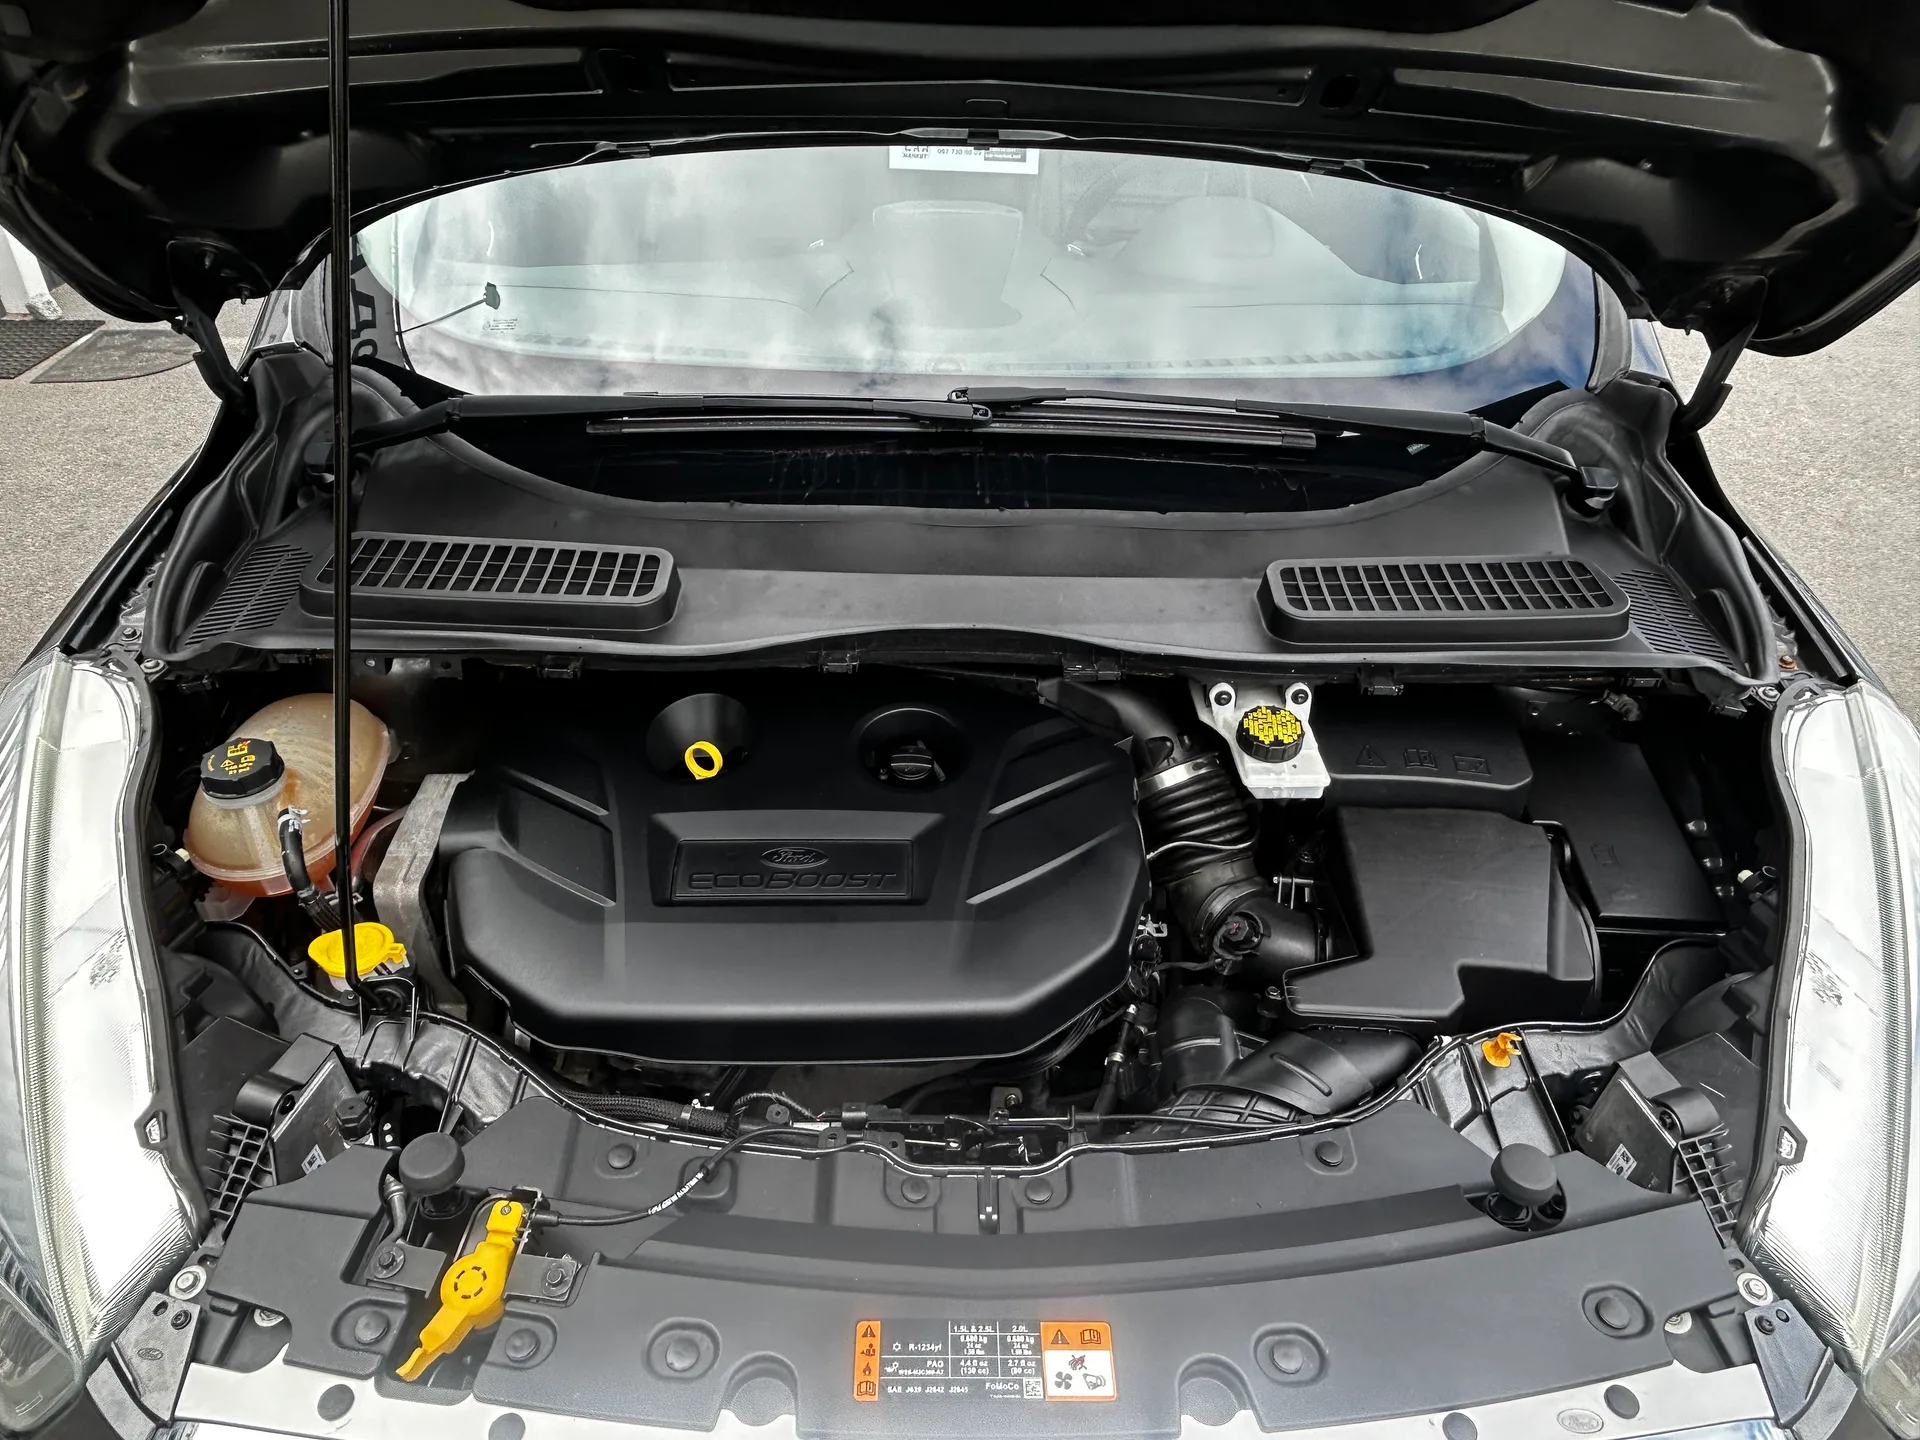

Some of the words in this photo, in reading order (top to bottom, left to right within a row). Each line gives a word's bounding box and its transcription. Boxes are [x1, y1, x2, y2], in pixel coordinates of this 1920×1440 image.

[769, 847, 819, 866] Ford
[978, 1325, 995, 1333] 2.5L
[1012, 1325, 1029, 1333] 2.0L
[1007, 1359, 1020, 1367] 2.7
[985, 1381, 1020, 1390] FoMoCo
